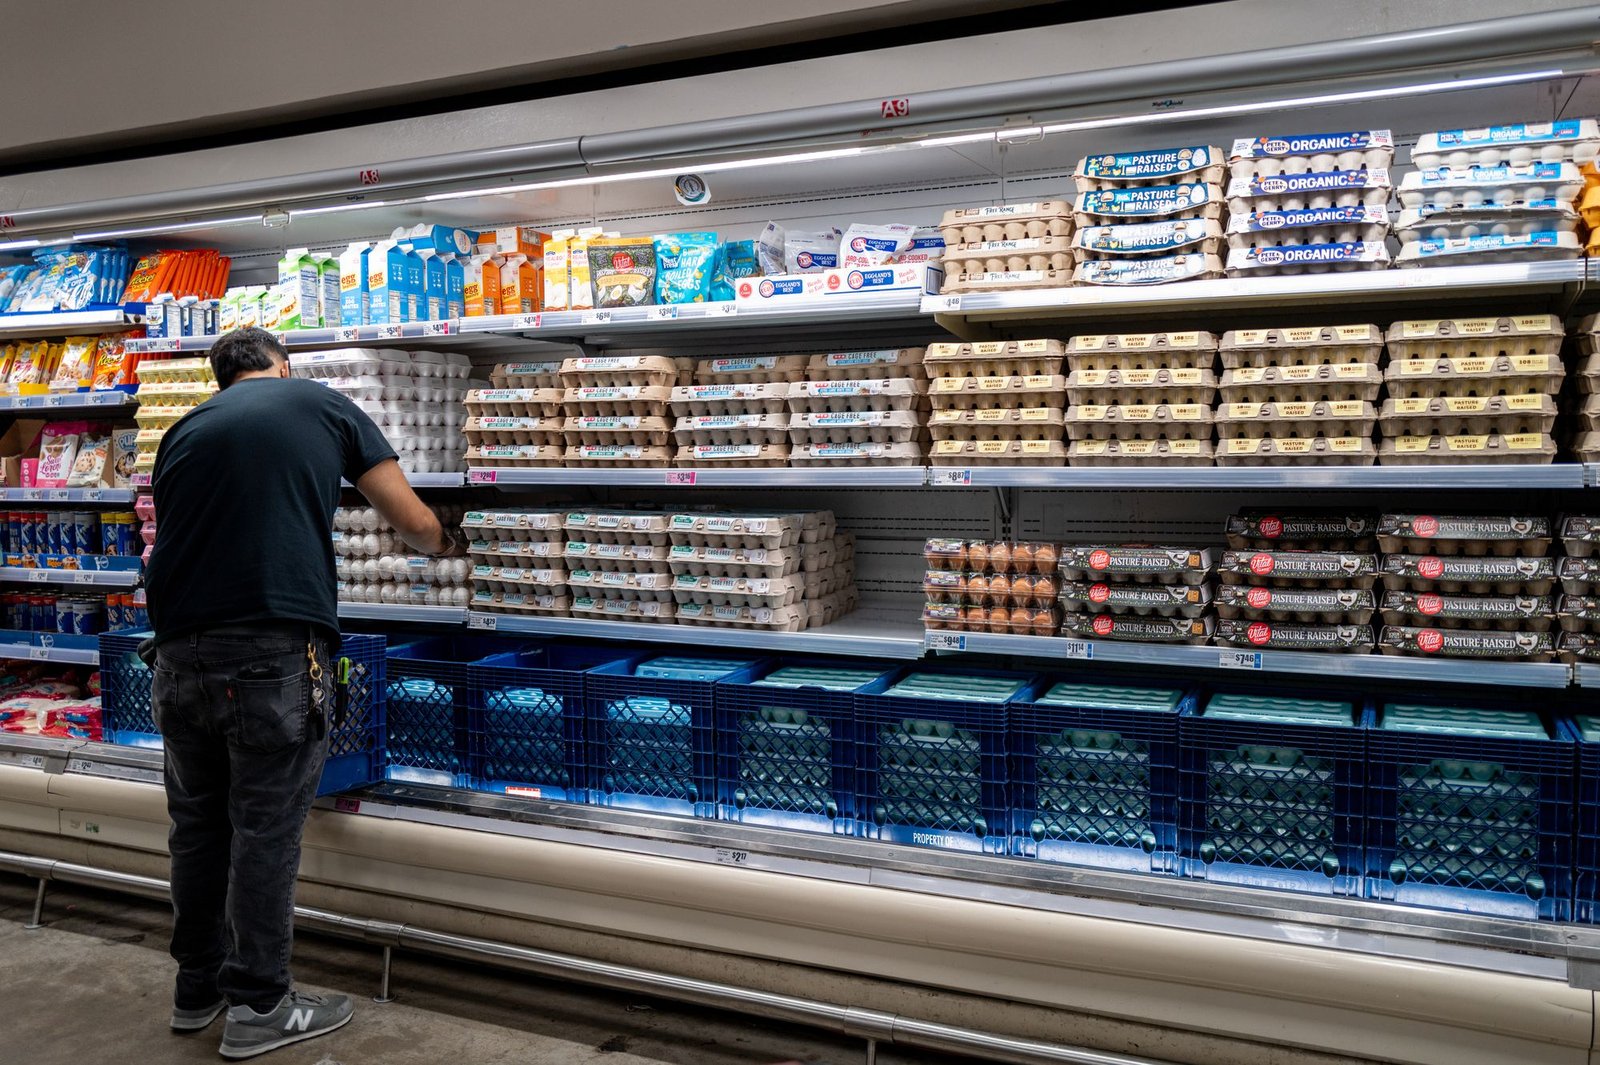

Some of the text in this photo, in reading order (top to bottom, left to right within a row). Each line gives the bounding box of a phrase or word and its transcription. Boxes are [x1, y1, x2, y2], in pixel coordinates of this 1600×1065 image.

[882, 99, 908, 118] A9
[1491, 130, 1523, 138] ORGANIC
[1291, 136, 1350, 151] ORGANIC
[1132, 153, 1177, 165] PASTURE
[1137, 163, 1173, 174] RAISED
[362, 170, 380, 185] A8
[1289, 175, 1348, 189] ORGANIC
[1131, 190, 1176, 201] PASTURE
[1135, 200, 1172, 211] RAISED
[1287, 211, 1346, 224] ORGANIC
[1285, 248, 1344, 261] ORGANIC
[342, 273, 356, 284] egg
[370, 272, 384, 283] egg
[464, 285, 478, 295] egg
[677, 280, 702, 290] EGGS
[502, 286, 516, 296] egg
[1260, 521, 1280, 532] Vital
[1283, 523, 1347, 532] PASTURE-RAISED
[1413, 519, 1437, 532] Vital
[1439, 523, 1511, 533] PASTURE-RAISED
[1090, 554, 1108, 564] Vital
[1110, 557, 1170, 567] PASTURE-RAISED
[1251, 557, 1272, 568] Vital
[1274, 560, 1340, 571] PASTURE-RAISED
[1418, 561, 1441, 572] Vital
[1444, 563, 1517, 574] PASTURE-RAISED
[1090, 588, 1108, 597] Vital
[1110, 590, 1169, 601] PASTURE-RAISED
[1248, 591, 1269, 602] Vital
[1271, 594, 1337, 605] PASTURE-RAISED
[1417, 598, 1441, 609] Vital
[1444, 601, 1516, 612] PASTURE-RAISED
[1093, 620, 1111, 630] Vital
[1114, 623, 1174, 634] PASTURE-RAISED
[1248, 627, 1269, 638] Vital
[1271, 630, 1337, 640] PASTURE-RAISED
[1417, 634, 1441, 646] Vital
[1444, 637, 1516, 649] PASTURE-RAISED
[913, 832, 944, 846] PROPERTY
[284, 1008, 314, 1031] N
